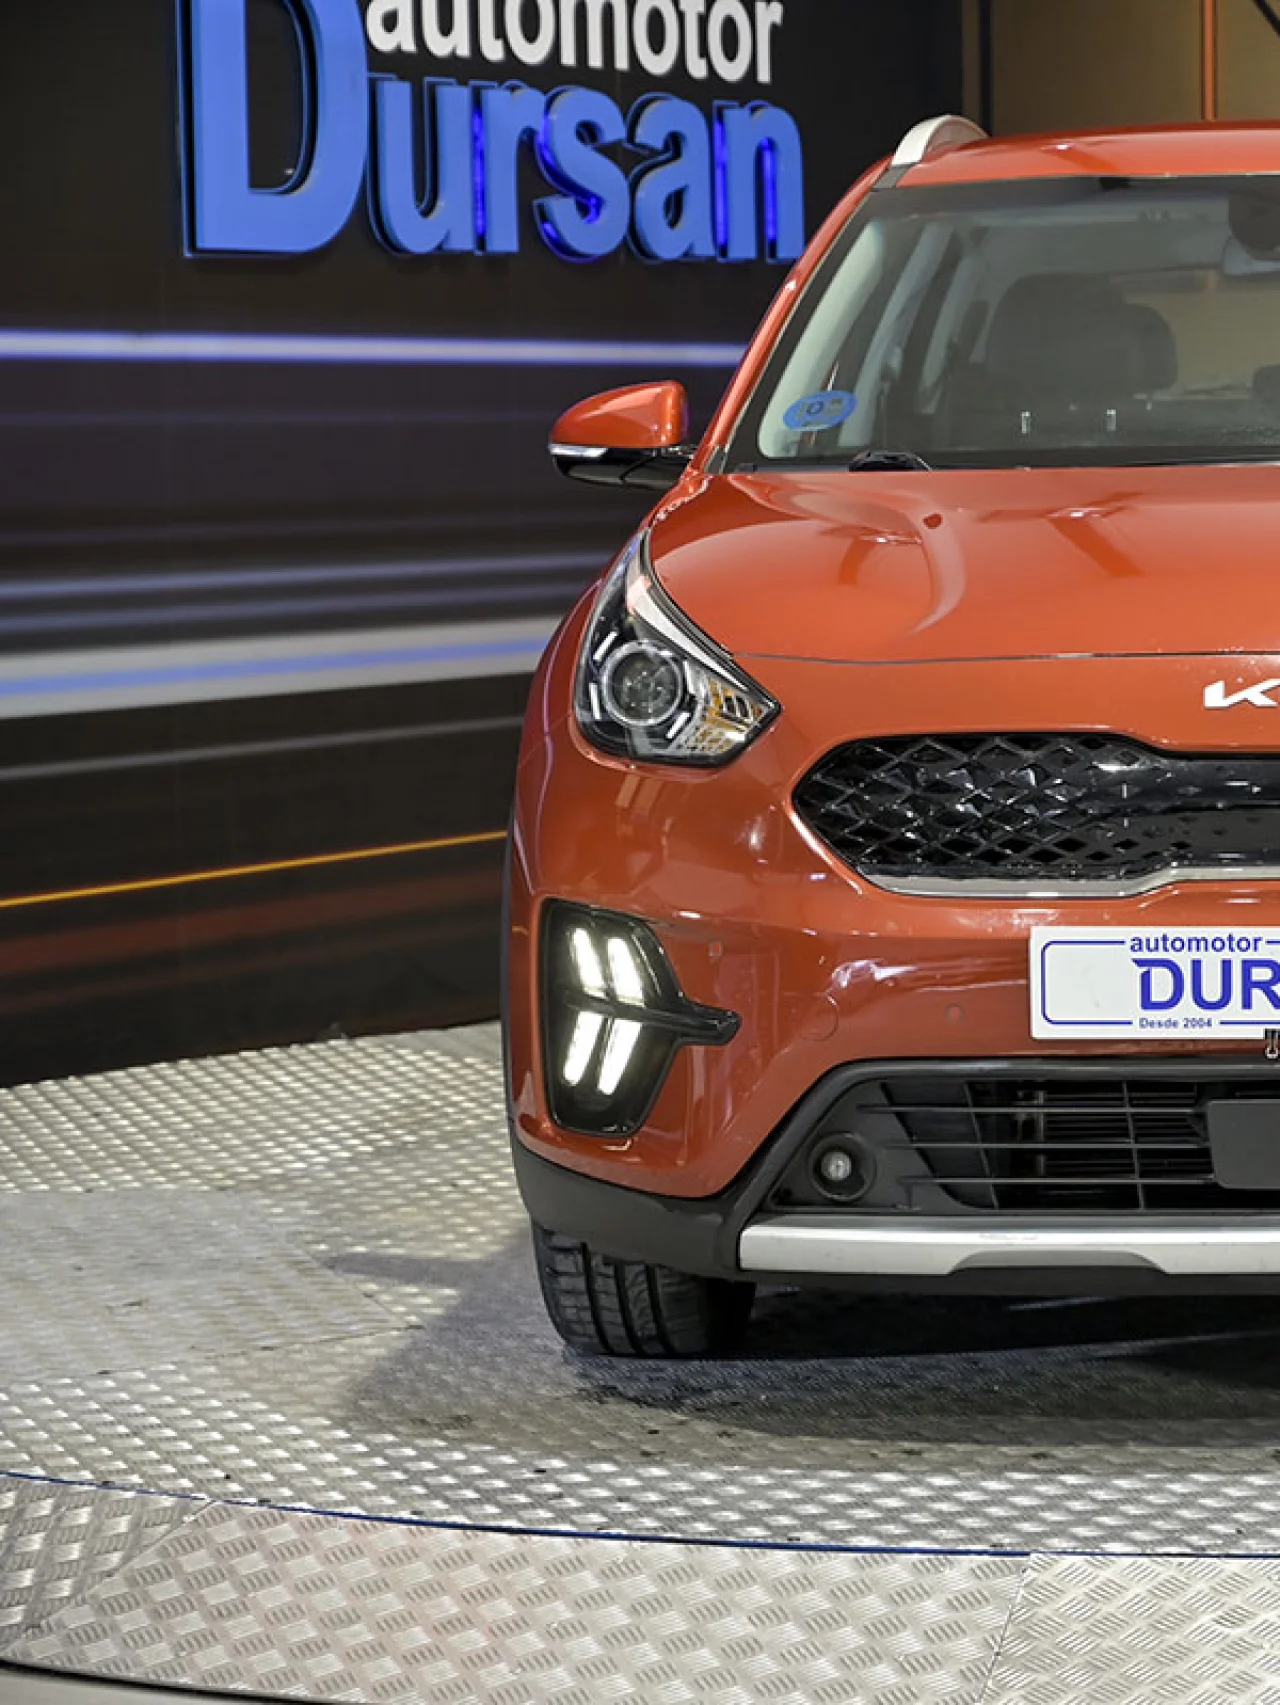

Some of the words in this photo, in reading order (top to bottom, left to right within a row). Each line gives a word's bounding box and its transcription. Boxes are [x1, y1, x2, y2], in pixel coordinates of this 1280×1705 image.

[367, 0, 782, 84] automotor
[180, 0, 806, 262] Dursan
[1130, 932, 1263, 954] automotor
[1138, 1016, 1180, 1029] Desde
[1183, 1016, 1214, 1029] 2004
